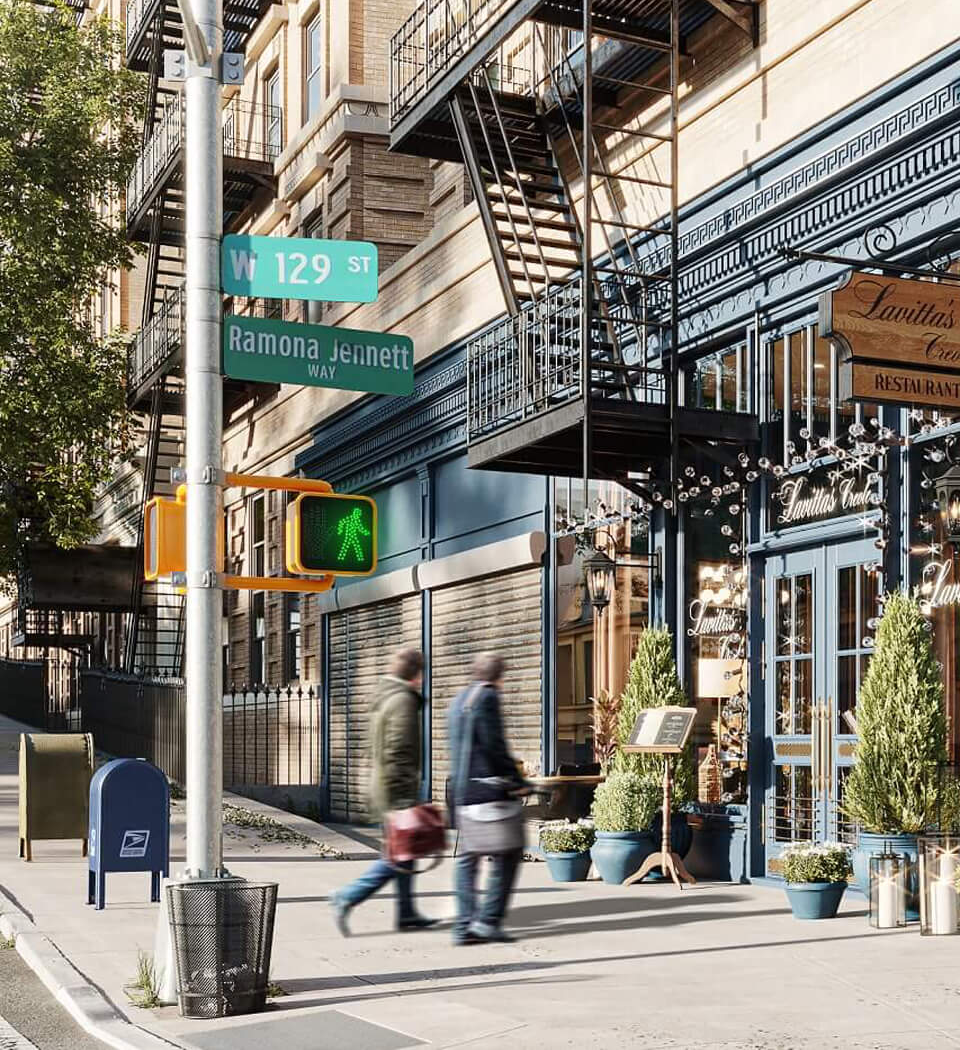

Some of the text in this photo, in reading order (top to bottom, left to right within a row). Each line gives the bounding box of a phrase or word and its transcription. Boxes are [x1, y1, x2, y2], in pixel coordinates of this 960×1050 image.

[229, 249, 371, 285] W 129 ST
[848, 279, 956, 329] Lavitta's
[229, 325, 409, 371] Ramona Jennett
[307, 364, 337, 379] WAY
